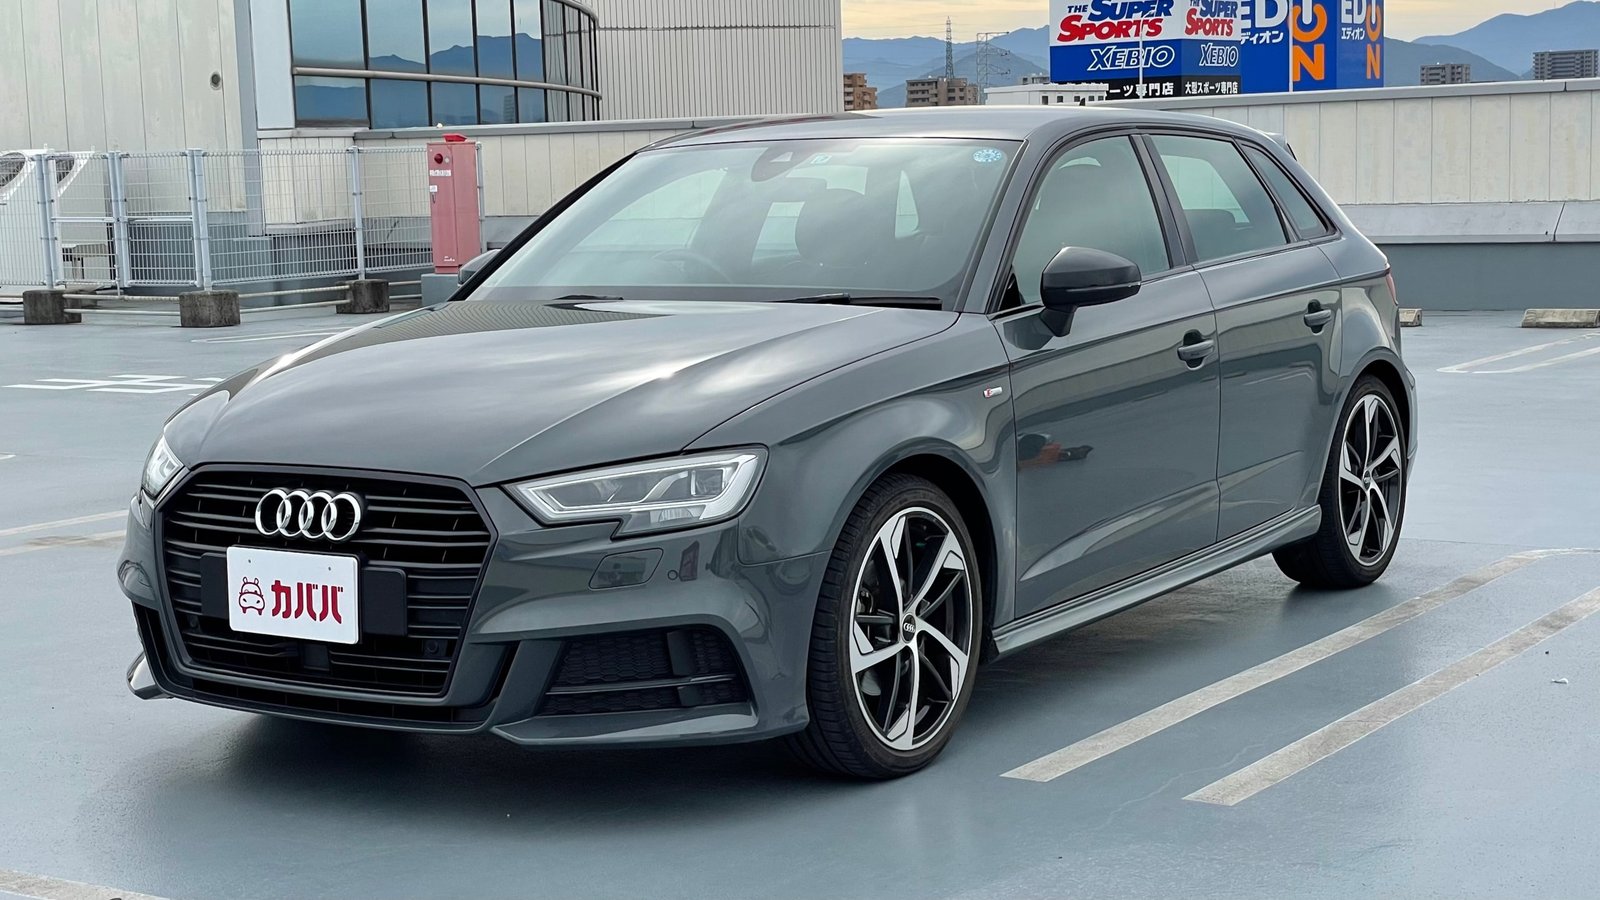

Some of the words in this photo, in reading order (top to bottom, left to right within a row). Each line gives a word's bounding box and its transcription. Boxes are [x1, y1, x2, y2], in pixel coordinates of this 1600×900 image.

[1067, 5, 1088, 13] THE
[1088, 0, 1174, 21] SUPER
[1200, 0, 1238, 18] SUPER
[1057, 15, 1163, 42] SPORTS
[1185, 8, 1233, 36] SPORTS
[1241, 31, 1284, 45] ディオン
[1341, 27, 1365, 40] エディオン
[1087, 45, 1175, 71] XEBIO
[1199, 43, 1239, 67] XEBIO
[1185, 81, 1238, 94] 大型スポーツ専門店
[271, 580, 344, 625] カババ
